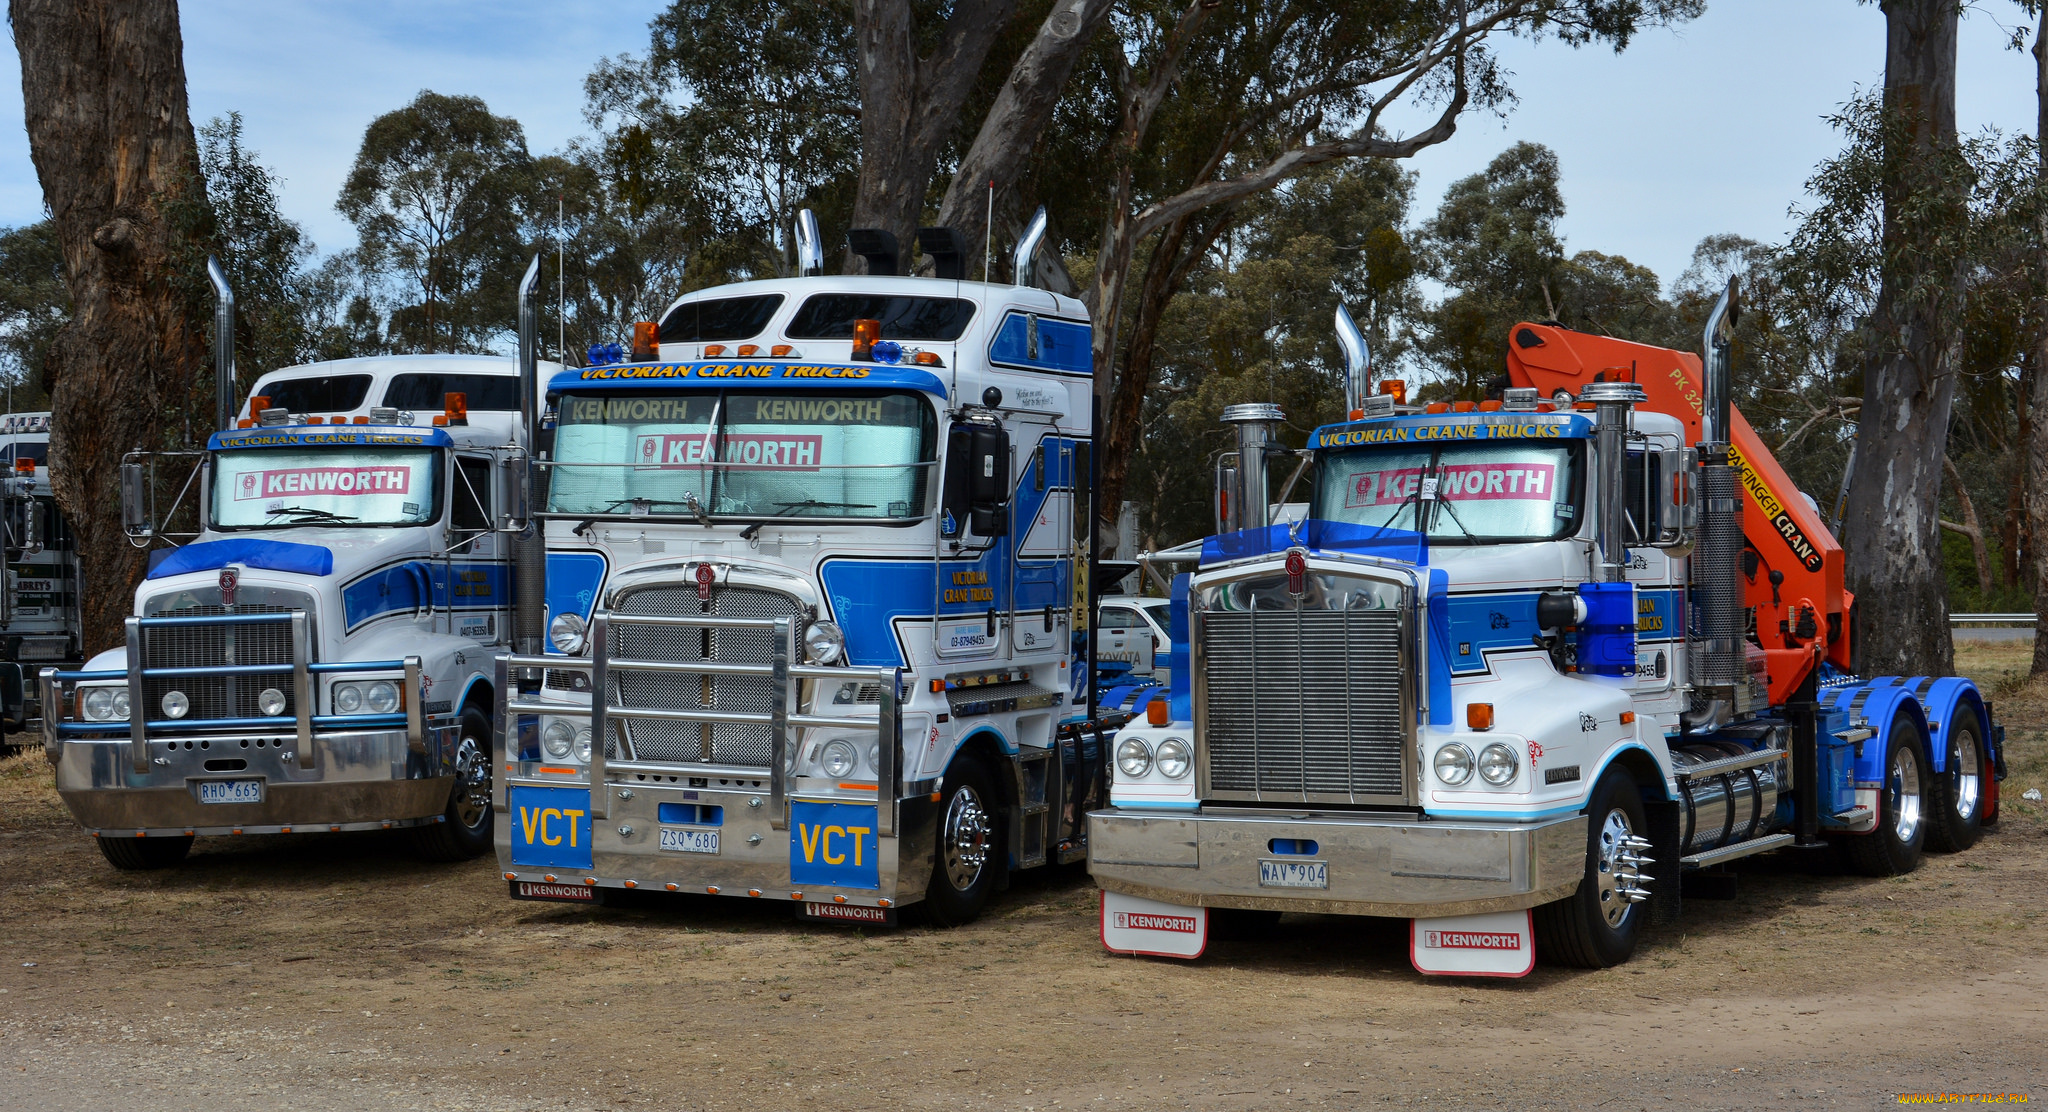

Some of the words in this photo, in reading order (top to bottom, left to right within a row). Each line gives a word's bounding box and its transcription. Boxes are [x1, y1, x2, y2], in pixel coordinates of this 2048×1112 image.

[581, 365, 694, 379] VICTORIAN
[697, 364, 776, 378] CRANE
[783, 365, 872, 378] TRUCKS
[1668, 368, 1689, 391] PK
[572, 400, 688, 420] KENWORTH
[756, 400, 882, 421] KENWORTH
[220, 435, 299, 447] VICTORIAN
[305, 434, 357, 443] CRANE
[365, 435, 424, 445] TRUCKS
[1319, 427, 1409, 447] VICTORIAN
[1414, 425, 1477, 440] CRANE
[1486, 424, 1560, 439] TRUCKS
[668, 440, 816, 466] KENWORTH
[268, 471, 404, 494] KENWORTH
[1383, 469, 1546, 499] KEWORTH
[1775, 515, 1820, 568] CRANE
[952, 571, 988, 586] VICTORIAN
[944, 588, 968, 604] CRANE
[970, 587, 994, 602] TRUCKS
[203, 784, 226, 798] RHO
[235, 783, 258, 797] 665
[520, 806, 584, 848] VCT
[662, 830, 684, 847] ZSQ
[695, 833, 718, 849] 680
[799, 823, 870, 866] VCT
[1260, 862, 1287, 881] WAV
[1299, 865, 1326, 882] 904
[533, 885, 592, 898] KENWORTH
[821, 905, 884, 920] KENWORTH
[1129, 915, 1195, 931] KENWORTH
[1442, 933, 1518, 948] KENWORTH
